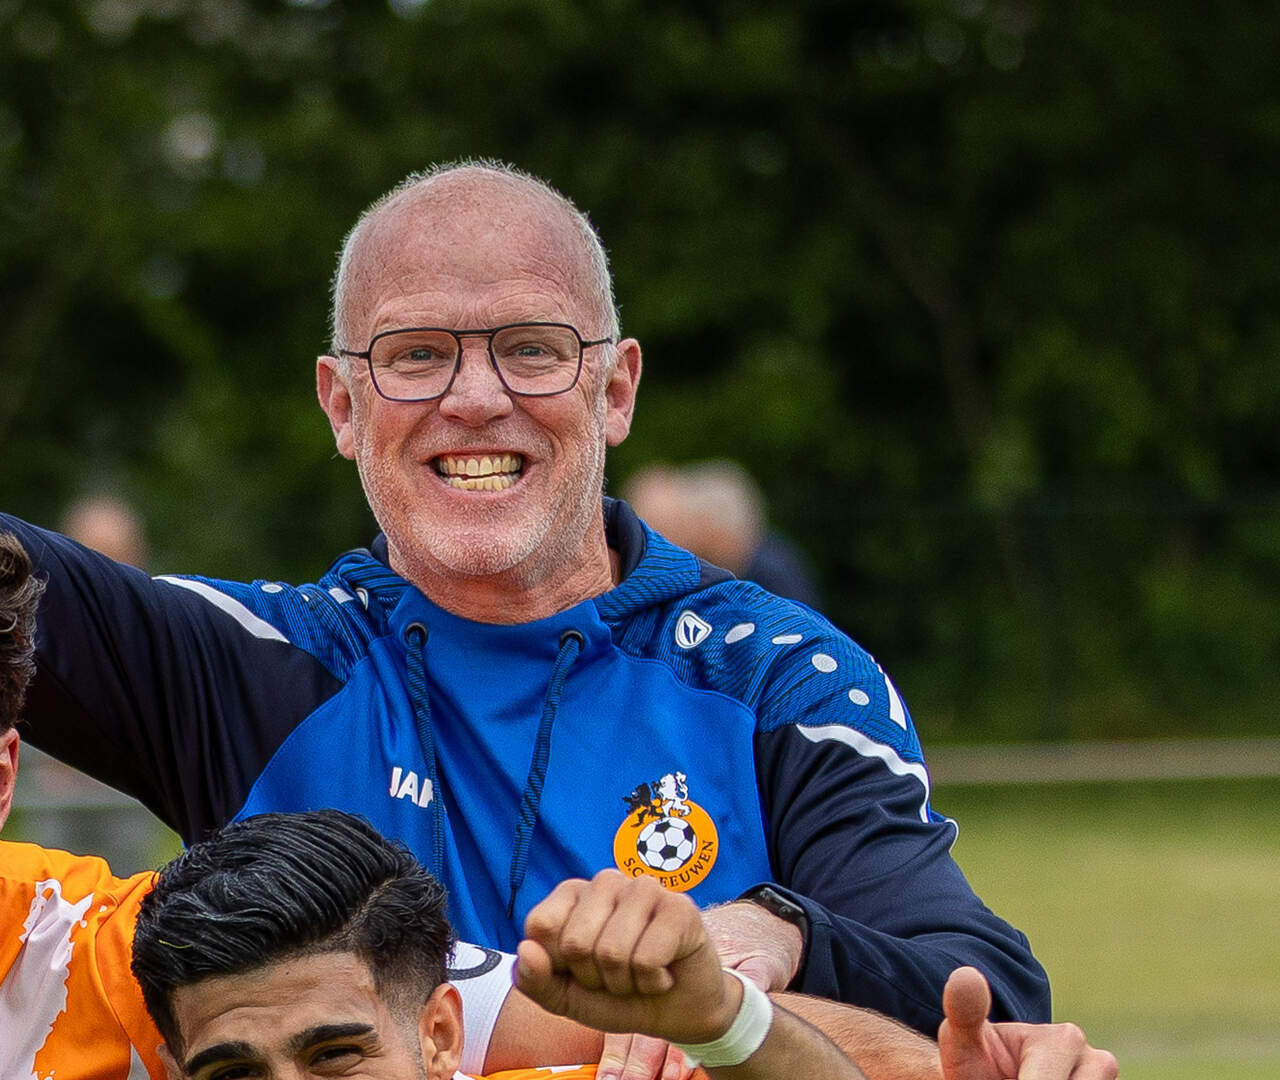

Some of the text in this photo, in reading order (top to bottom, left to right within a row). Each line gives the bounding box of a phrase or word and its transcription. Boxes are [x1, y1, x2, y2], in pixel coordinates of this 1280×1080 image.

[389, 766, 434, 809] JAK
[623, 840, 715, 888] S.C EEUWEN
